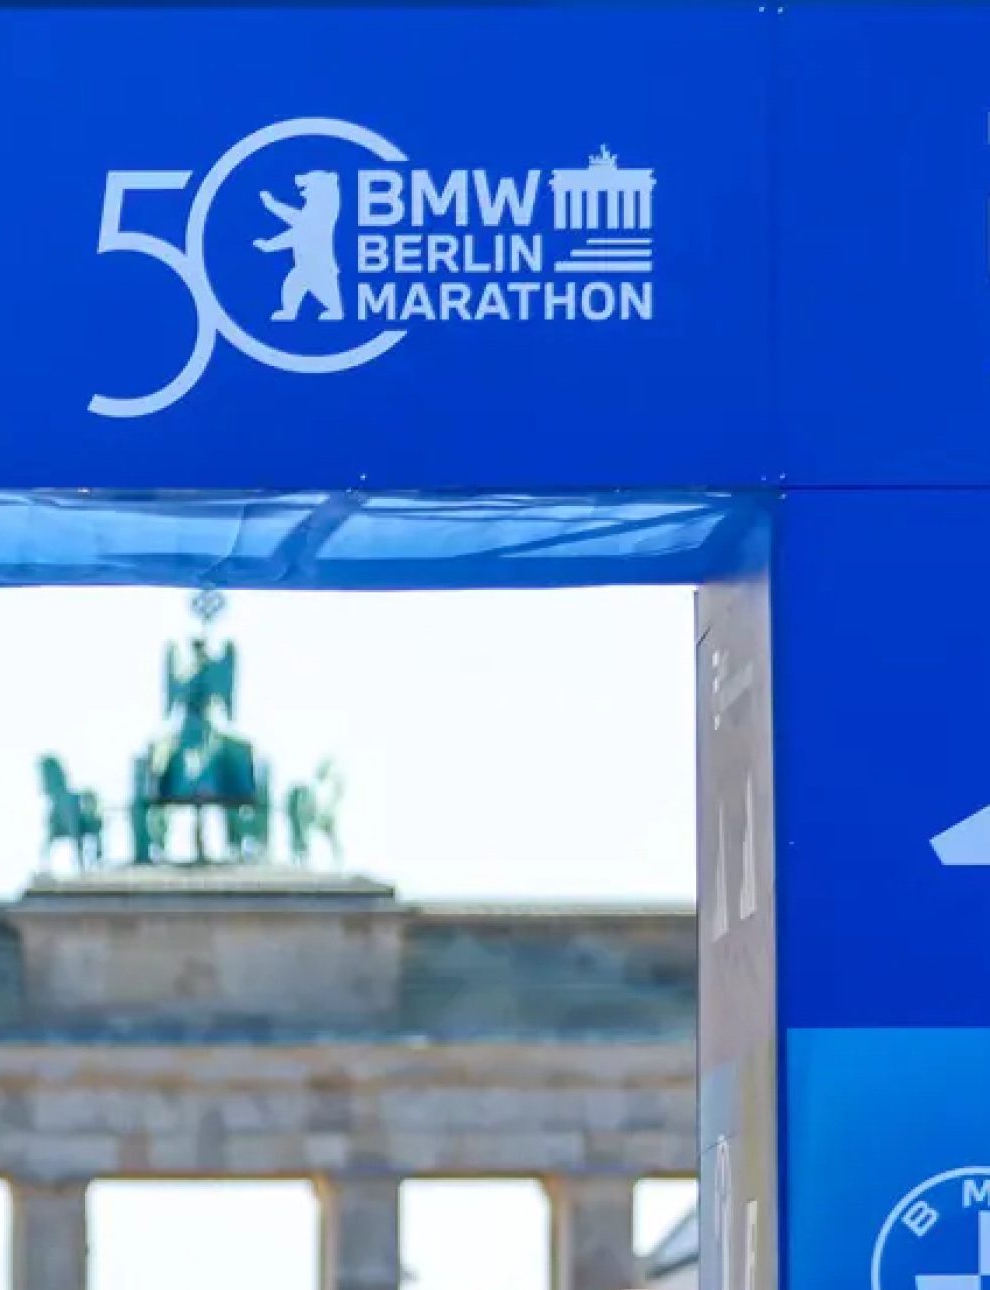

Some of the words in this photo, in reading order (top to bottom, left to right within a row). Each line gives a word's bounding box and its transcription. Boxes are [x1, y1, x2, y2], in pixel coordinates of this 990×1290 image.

[357, 170, 541, 227] BMW
[357, 235, 542, 273] BERLIN
[357, 282, 653, 321] MARATHON
